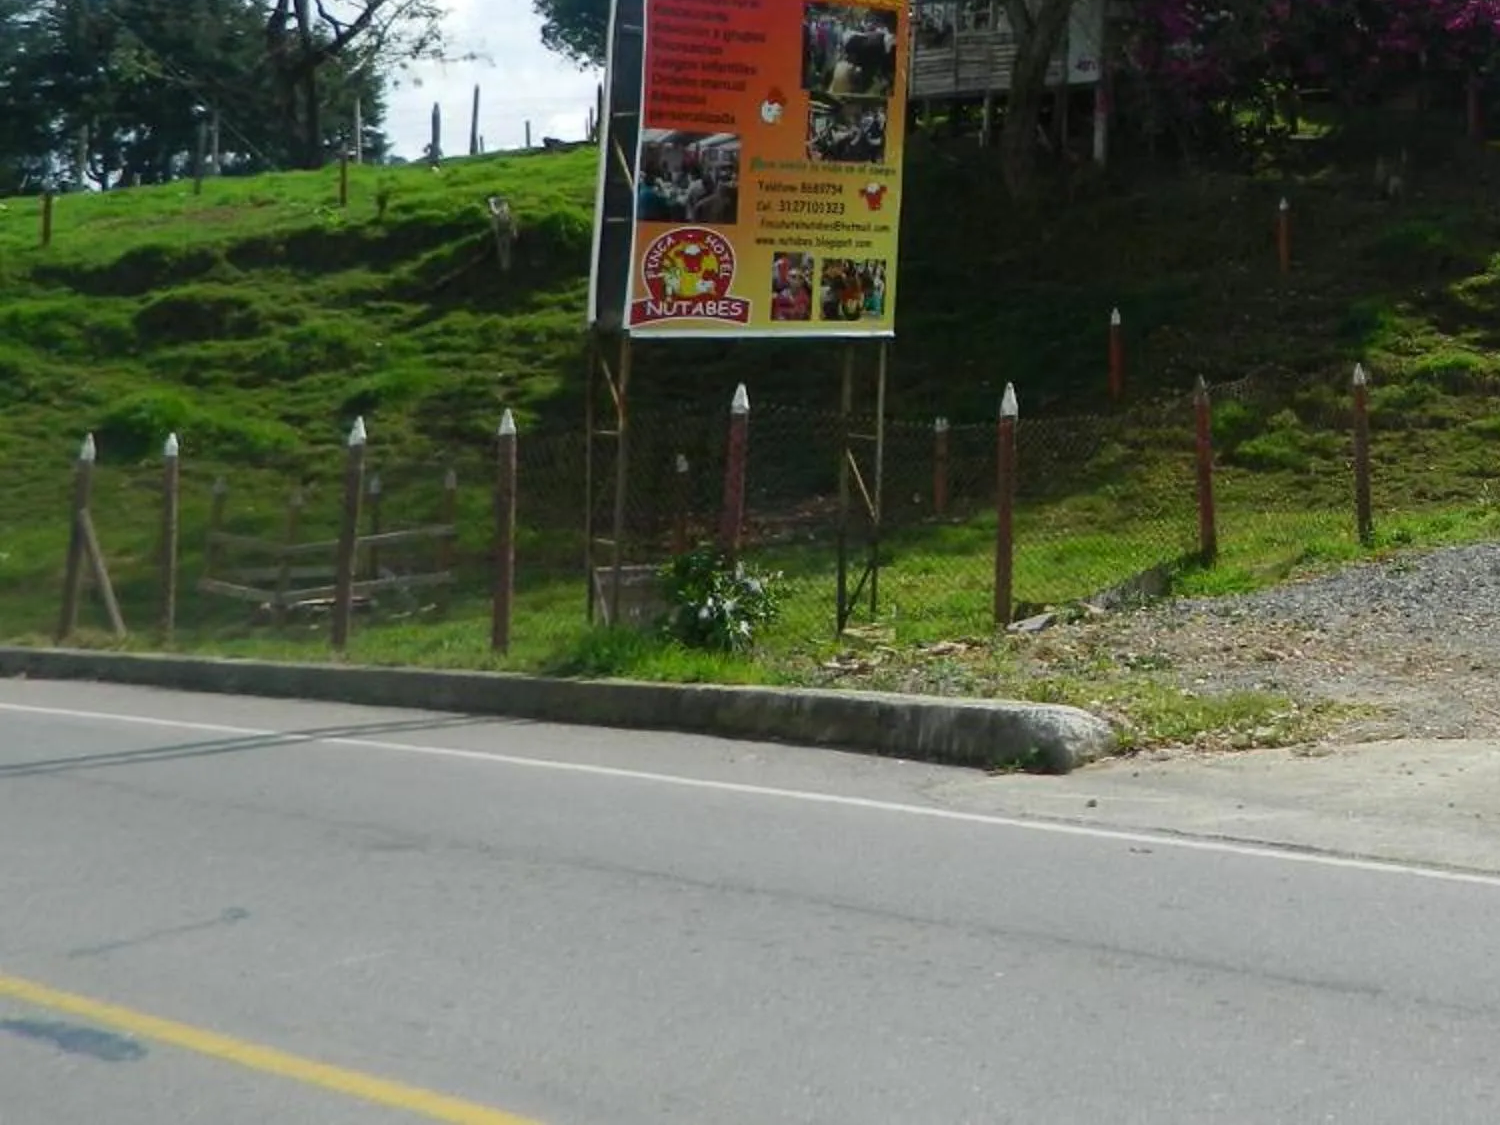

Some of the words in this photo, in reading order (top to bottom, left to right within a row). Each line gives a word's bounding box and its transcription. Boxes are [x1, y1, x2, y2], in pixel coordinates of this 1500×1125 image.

[645, 235, 676, 280] FINCA
[704, 234, 733, 278] HOTEL
[645, 300, 744, 317] NUTABES
